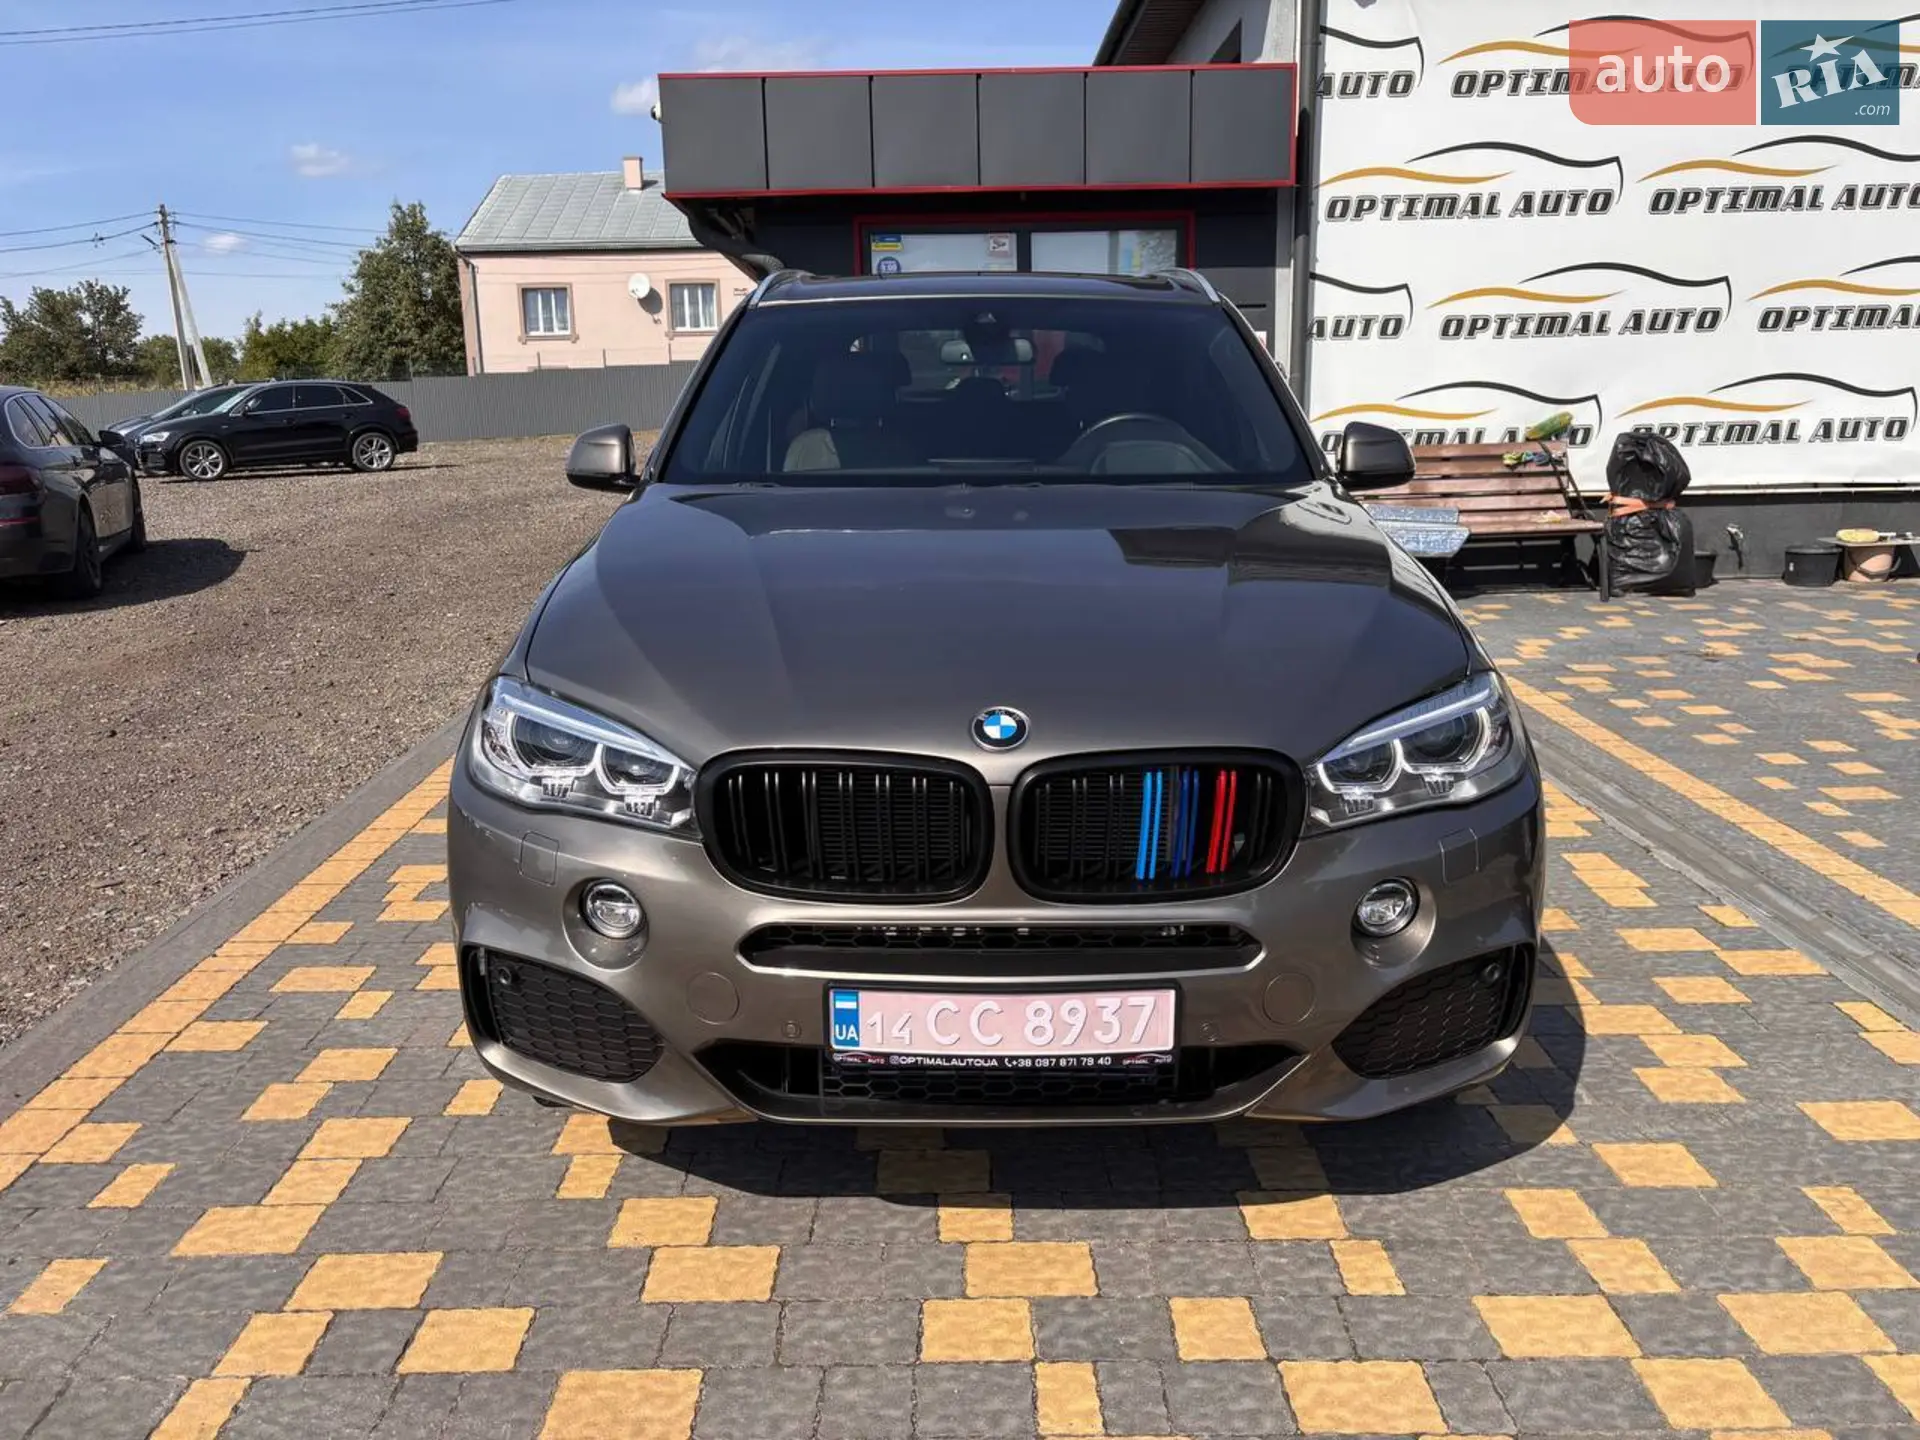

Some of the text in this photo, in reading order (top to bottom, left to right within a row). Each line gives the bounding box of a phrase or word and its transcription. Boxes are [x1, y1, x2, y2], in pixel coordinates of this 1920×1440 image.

[1316, 70, 1416, 99] AUTO
[1325, 189, 1624, 221] OPTIMAL AUTO
[1648, 185, 1824, 214] OPTIMAL
[1308, 315, 1404, 340] AUTO
[1439, 307, 1724, 340] OPTIMAL AUTO
[1808, 417, 1909, 442] AUTO
[835, 1023, 858, 1041] UA
[866, 996, 1156, 1046] 14 CC 8937
[1098, 1056, 1112, 1066] 40
